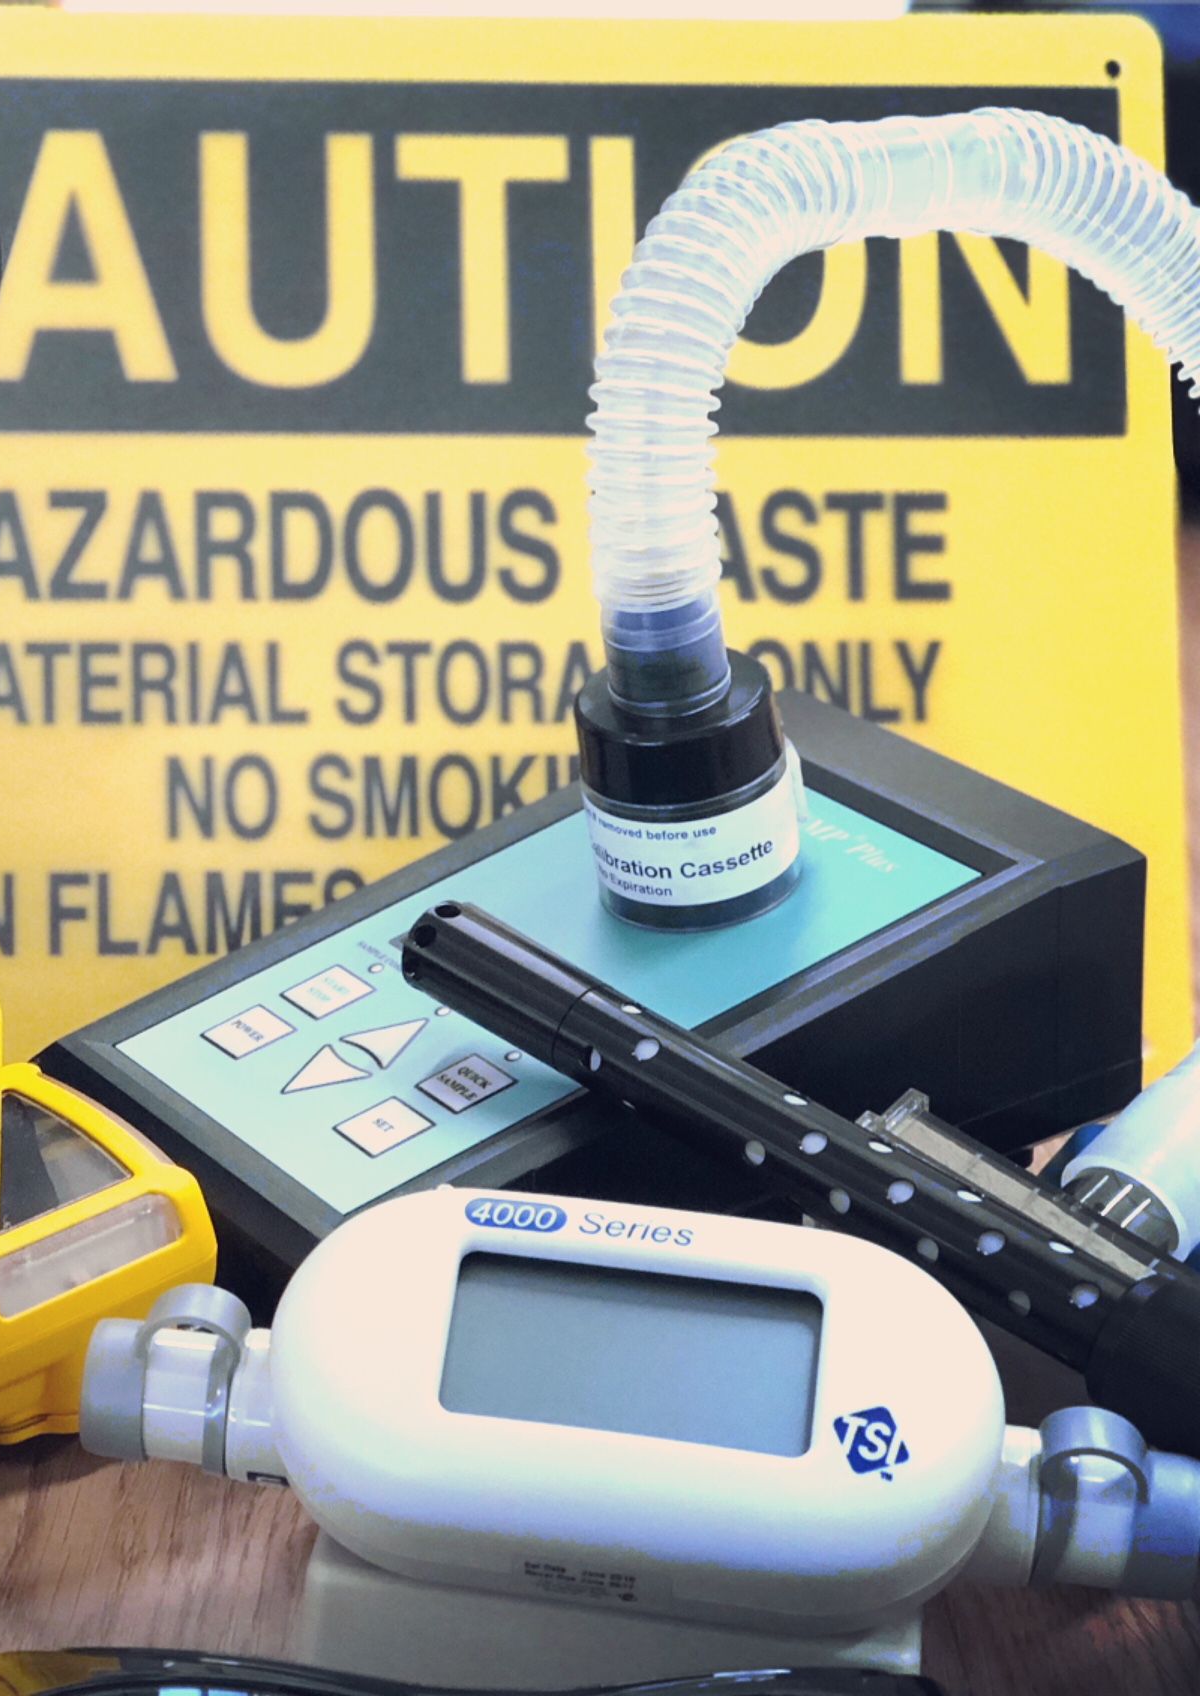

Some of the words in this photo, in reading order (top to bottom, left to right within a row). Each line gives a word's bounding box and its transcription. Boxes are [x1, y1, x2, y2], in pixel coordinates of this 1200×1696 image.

[710, 488, 952, 604] ASTE
[166, 754, 279, 839] NO
[646, 829, 689, 841] before
[693, 826, 717, 839] use
[591, 842, 673, 880] alibration
[680, 839, 774, 879] Cassette
[230, 1018, 265, 1043] POWER
[435, 1072, 478, 1101] SAMPLE
[456, 1065, 493, 1090] QUICK
[372, 1116, 396, 1132] SET
[470, 1200, 559, 1230] 4000
[578, 1212, 694, 1247] Series
[838, 1411, 903, 1468] TSI
